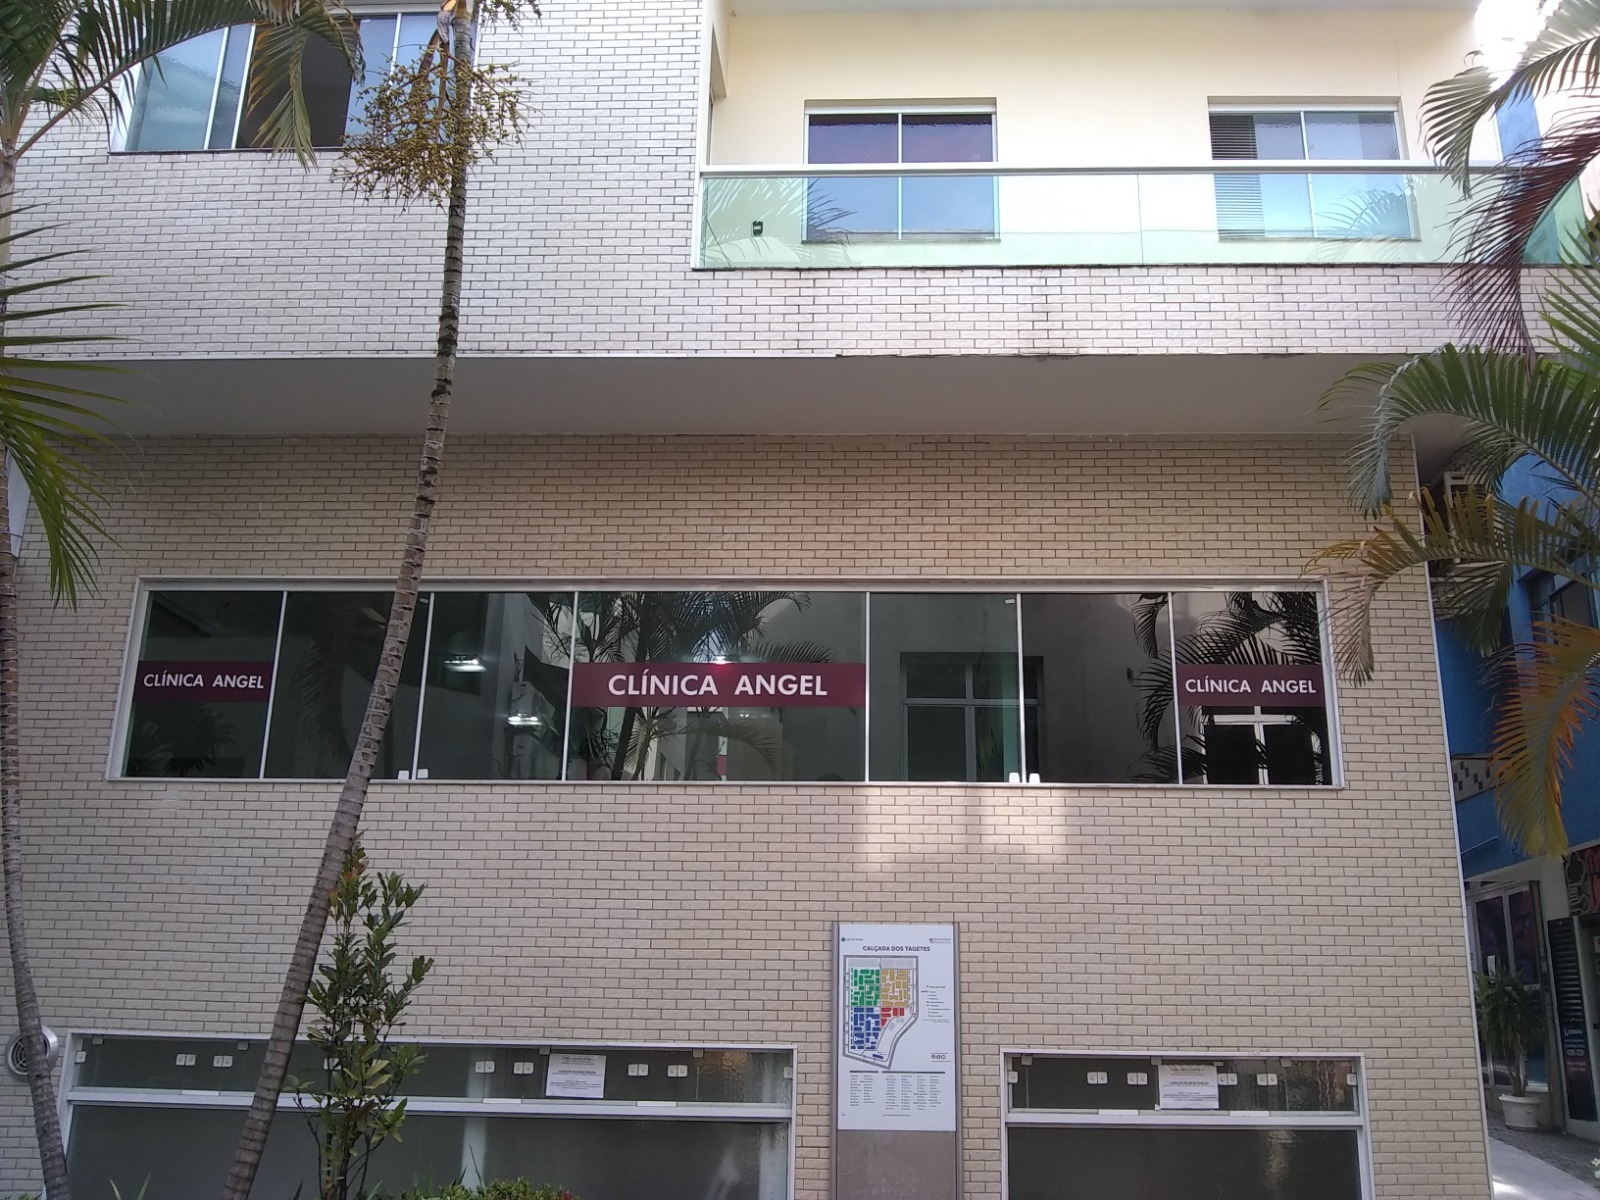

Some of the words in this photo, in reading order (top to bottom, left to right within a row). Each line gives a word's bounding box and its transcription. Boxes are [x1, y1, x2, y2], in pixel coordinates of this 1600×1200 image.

[143, 670, 204, 687] CLÍNICA
[212, 674, 264, 689] ANGEL
[608, 668, 718, 696] CLÍNICA
[734, 674, 828, 696] ANGEL
[1185, 675, 1252, 693] CLÍNICA
[1260, 679, 1317, 694] ANGEL
